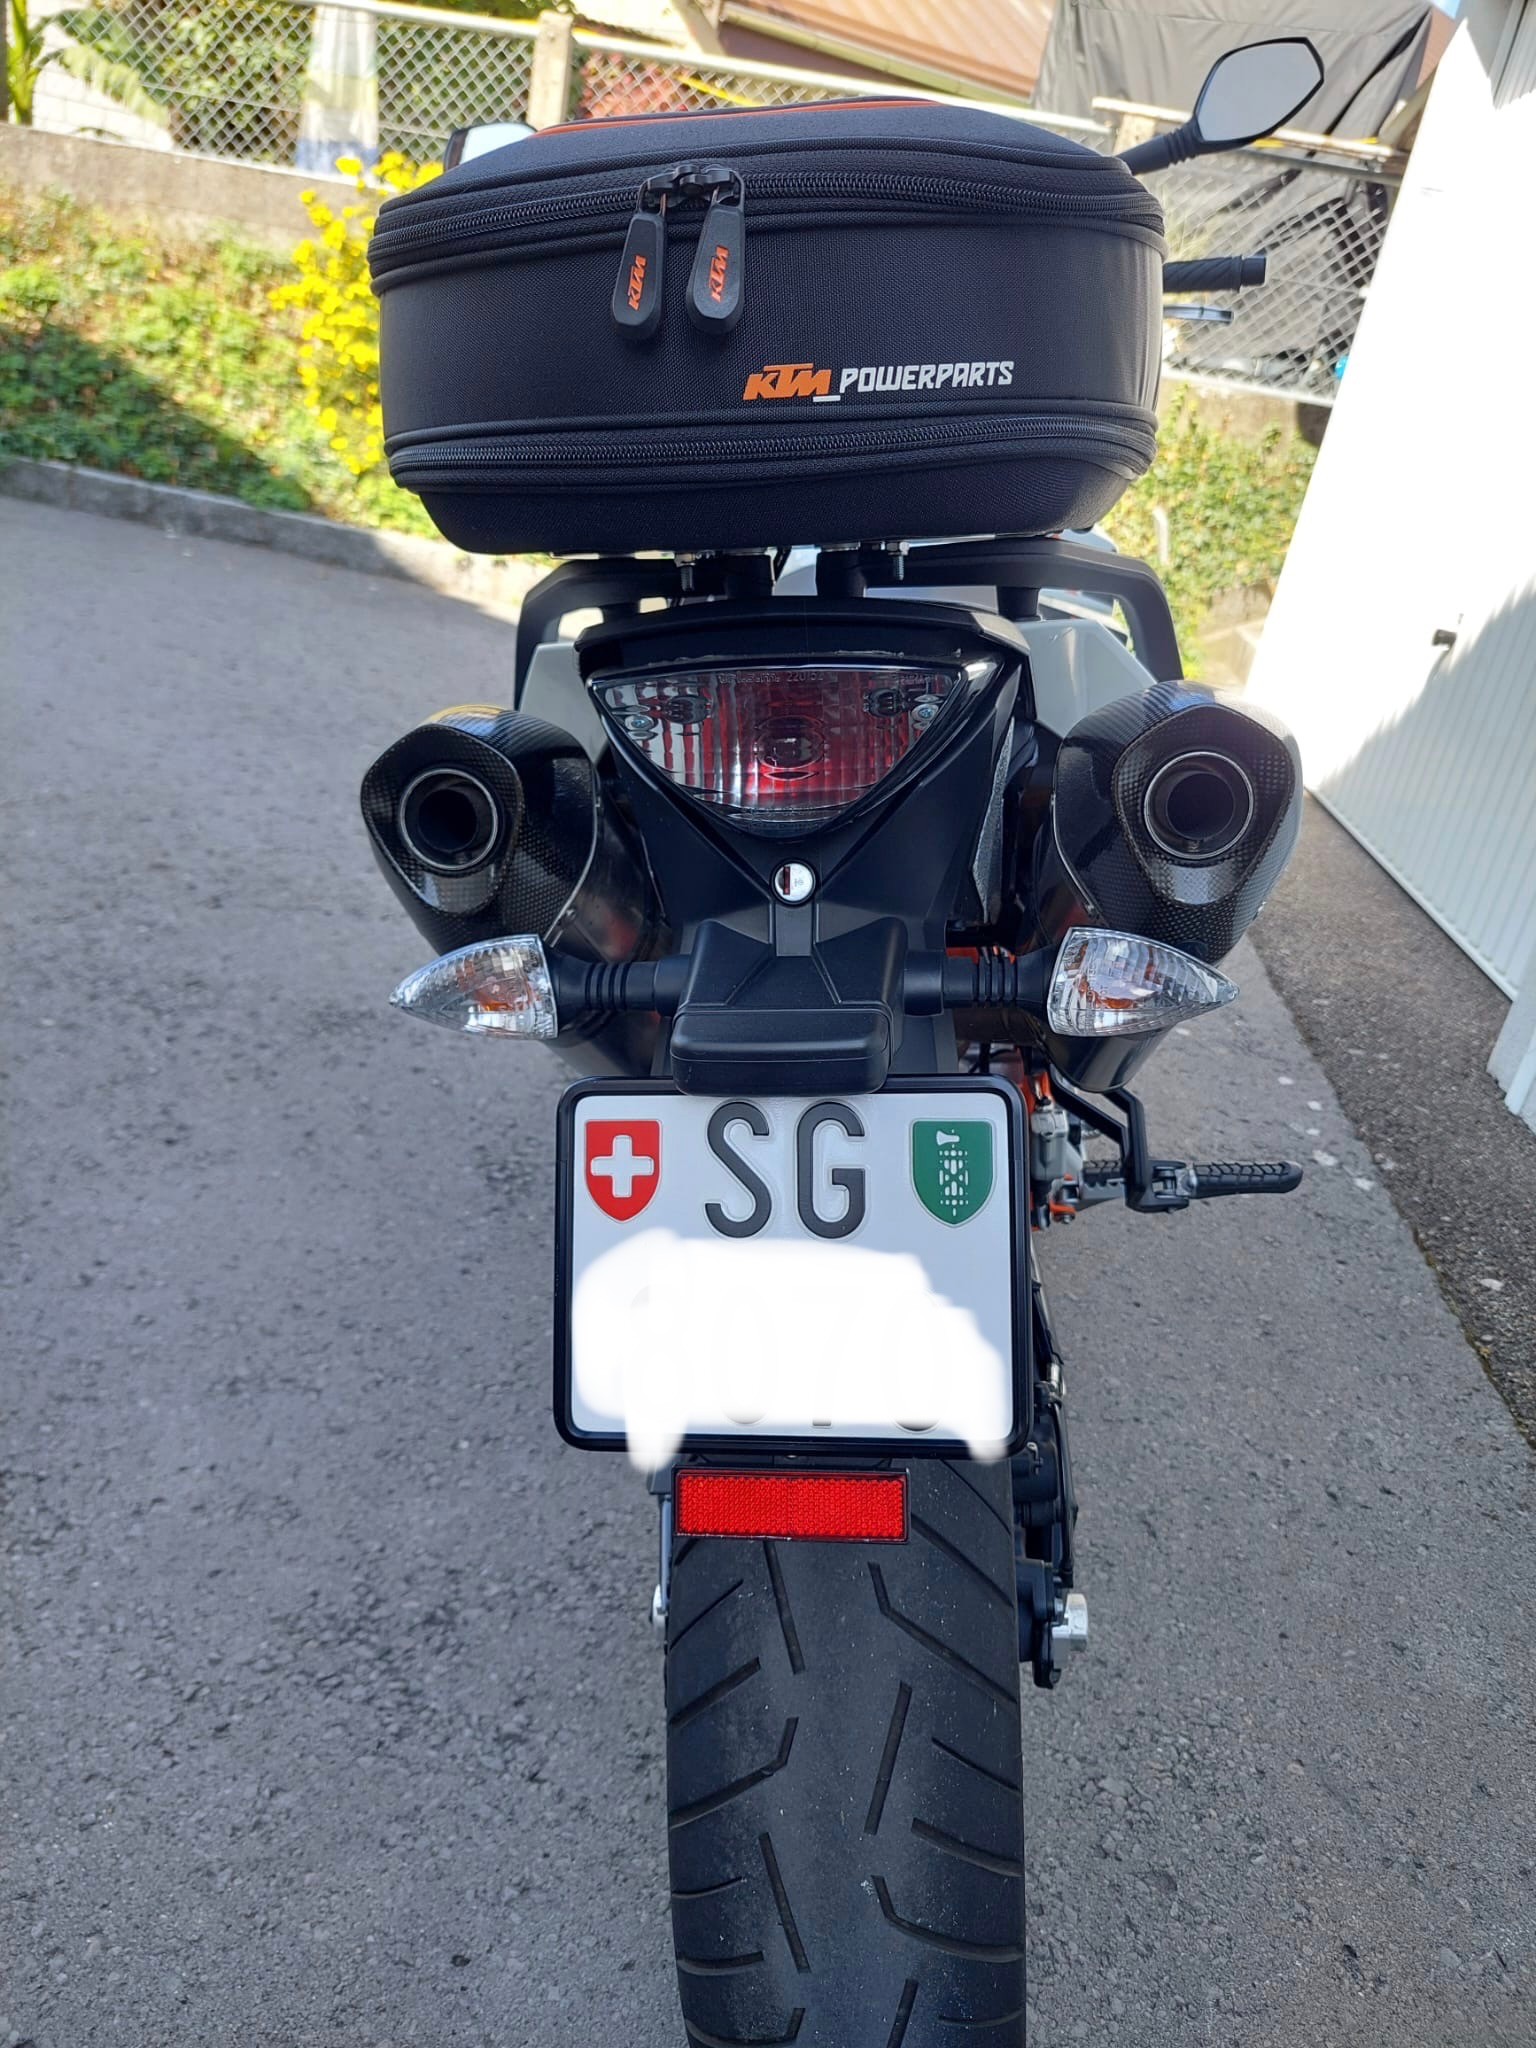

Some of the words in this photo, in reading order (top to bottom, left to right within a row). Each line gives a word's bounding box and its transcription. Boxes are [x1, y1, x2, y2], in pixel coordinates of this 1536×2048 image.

[629, 255, 648, 311] KTM
[709, 245, 729, 302] KTM
[742, 363, 832, 402] KTM
[838, 361, 1015, 394] POWERPARTS
[704, 1100, 867, 1240] SG
